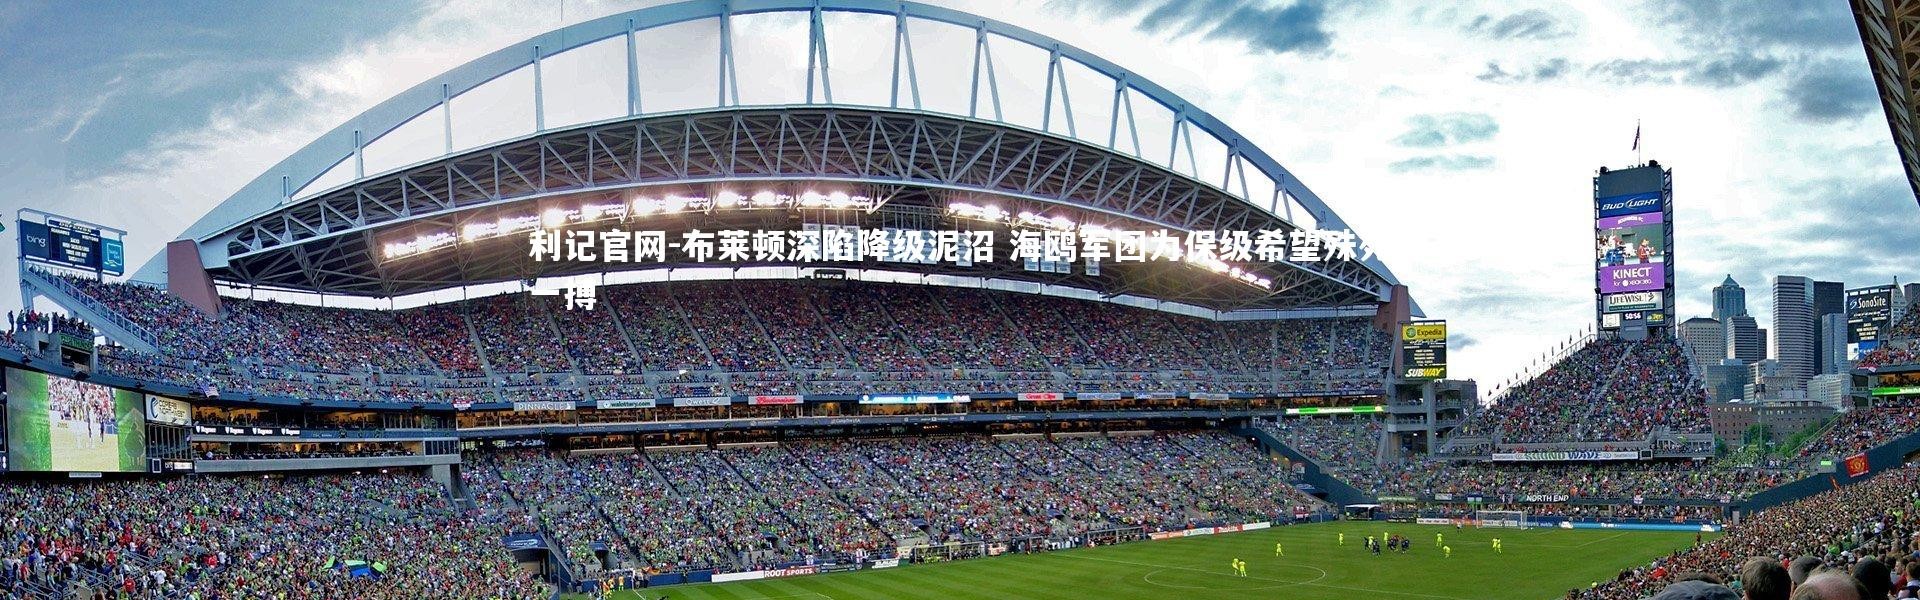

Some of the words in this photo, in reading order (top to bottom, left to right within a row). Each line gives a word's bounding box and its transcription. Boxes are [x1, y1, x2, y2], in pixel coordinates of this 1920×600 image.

[1628, 199, 1658, 207] LIGHT
[26, 234, 46, 248] bing
[1613, 267, 1652, 279] KINECT
[1858, 296, 1886, 309] SonoSite
[1417, 329, 1442, 337] Expedia
[1405, 368, 1445, 377] SUBWAY
[518, 402, 564, 410] PINNACLE
[611, 401, 650, 410] walottery.com
[686, 398, 710, 406] Qwest
[1527, 494, 1552, 502] NORTH
[1553, 494, 1569, 502] END
[765, 569, 785, 578] ROOT
